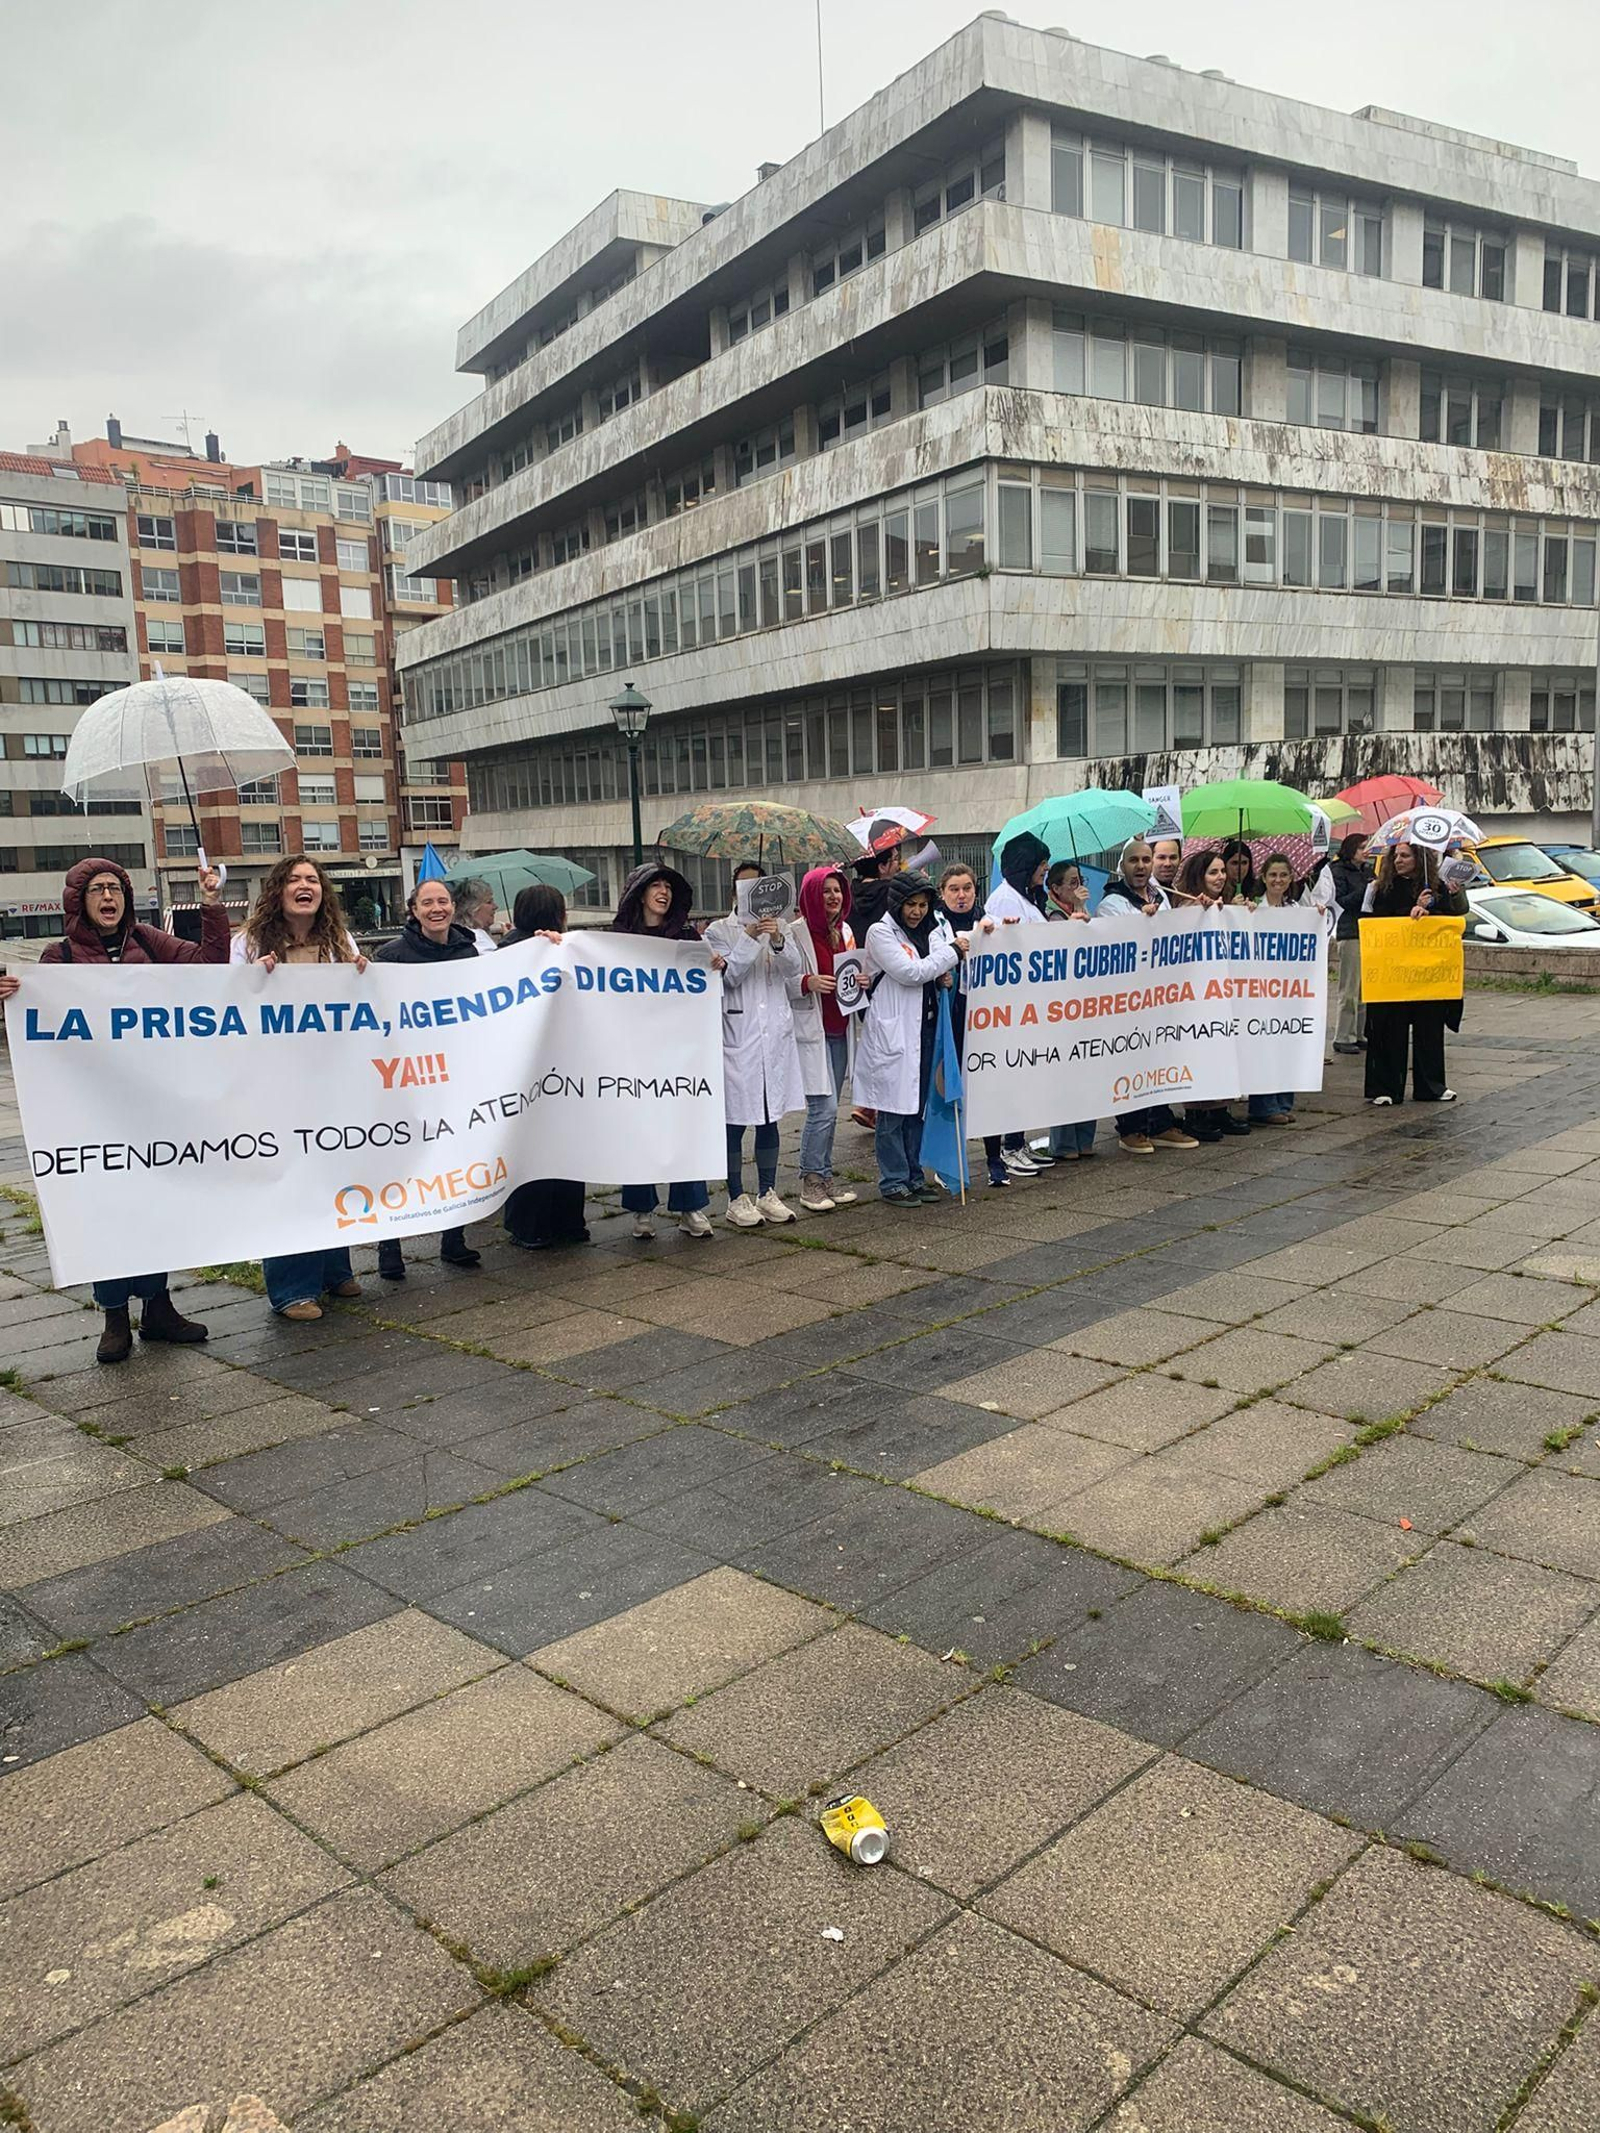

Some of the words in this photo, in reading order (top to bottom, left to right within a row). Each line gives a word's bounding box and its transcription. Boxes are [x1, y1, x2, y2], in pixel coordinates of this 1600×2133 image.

[1422, 822, 1442, 834] 30
[758, 881, 783, 895] STOP
[21, 902, 62, 913] RE/MAX
[1028, 948, 1068, 983] SEN
[1074, 941, 1138, 979] CUBRIR
[1141, 950, 1148, 962] =
[1253, 932, 1317, 962] ATENDER
[842, 974, 856, 991] 30
[26, 1008, 93, 1041] LA
[110, 1005, 248, 1040] PRISA
[260, 1002, 391, 1037] MATA,
[400, 966, 563, 1030] AGENDAS
[574, 964, 708, 995] DIGNAS
[1020, 1003, 1039, 1026] A
[1047, 981, 1196, 1023] SOBRECARGA
[1006, 1047, 1061, 1068] UNHA
[1068, 1026, 1152, 1062] ATENCIÓN
[371, 1052, 450, 1090] YA!!!
[32, 1131, 280, 1178] DEFENDAMOS
[293, 1120, 413, 1155] TODOS
[422, 1118, 455, 1143] LA
[468, 1066, 585, 1130] ATENCIÓN
[597, 1075, 713, 1099] PRIMARIA
[389, 1210, 433, 1223] Facultativos
[432, 1208, 443, 1216] de
[443, 1201, 468, 1214] Galicia
